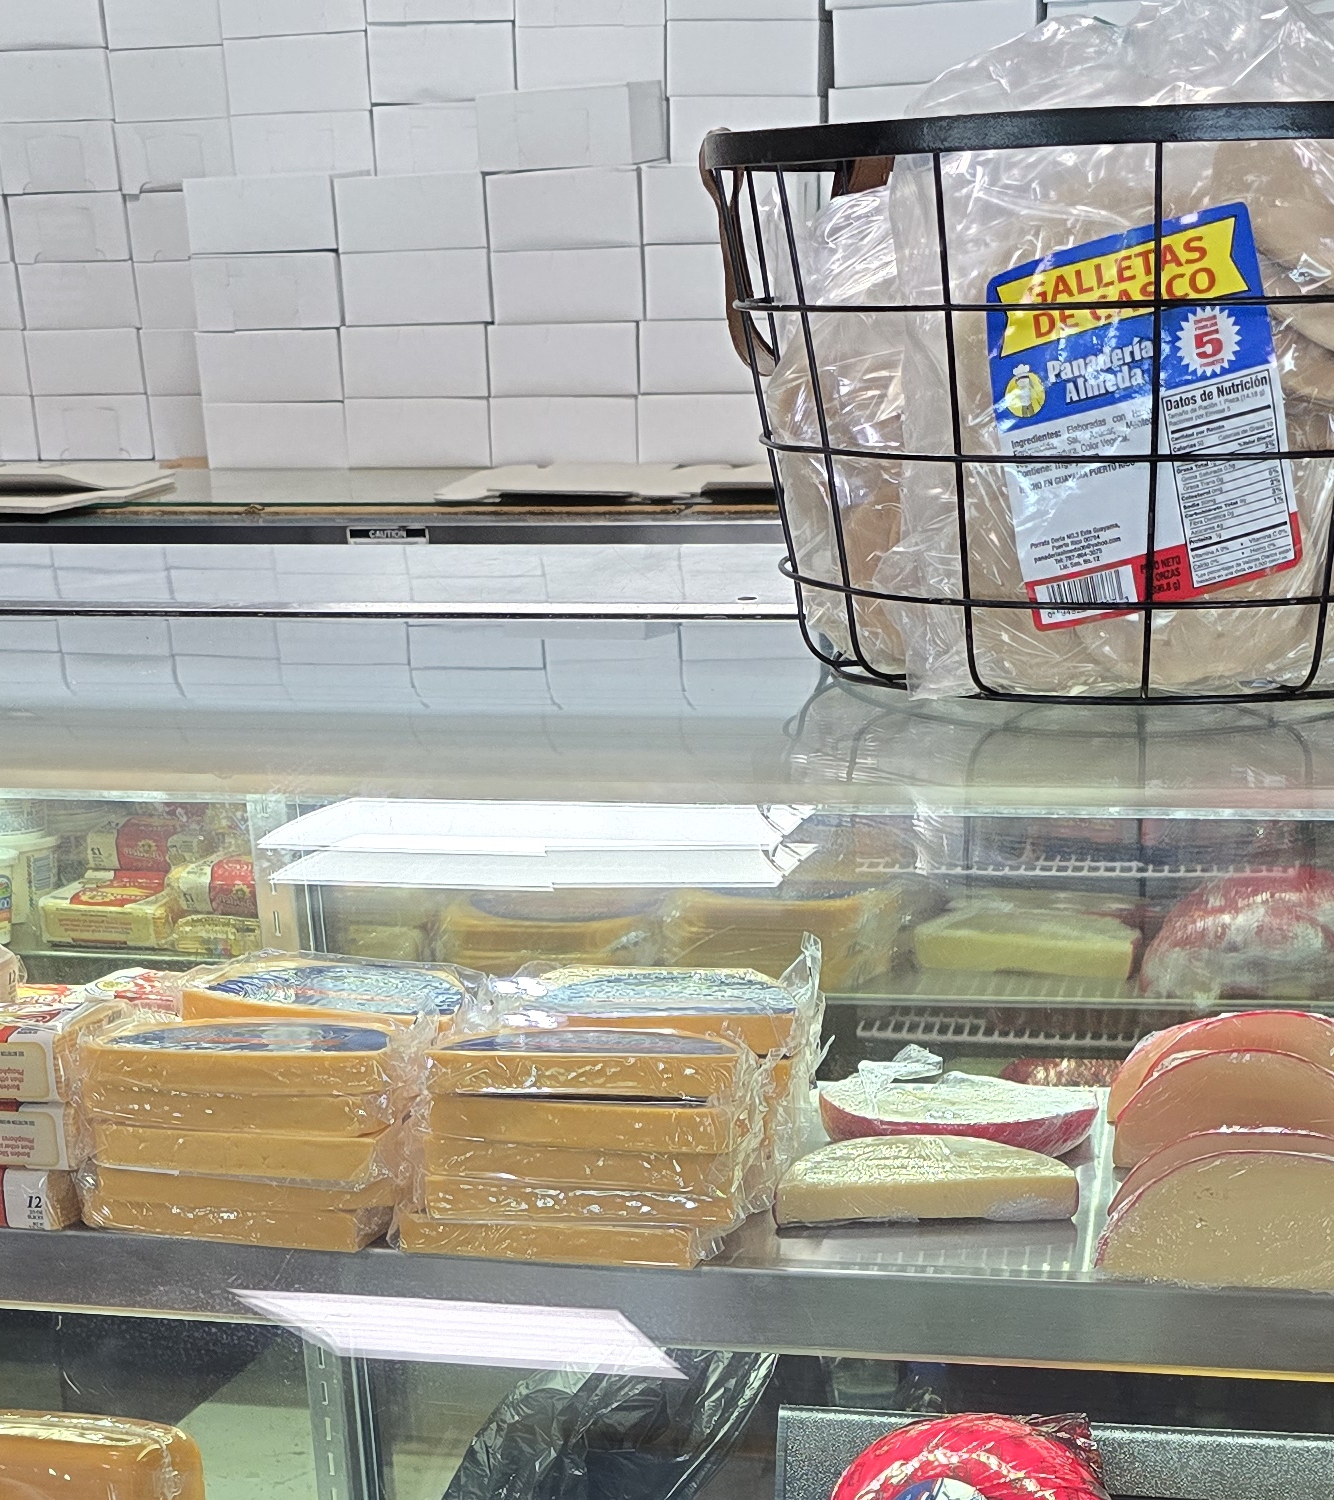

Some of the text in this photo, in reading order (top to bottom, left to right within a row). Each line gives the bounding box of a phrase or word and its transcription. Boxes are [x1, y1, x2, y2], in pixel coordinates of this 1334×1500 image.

[1193, 328, 1223, 359] 5
[1065, 366, 1145, 404] Almeda
[1166, 375, 1267, 411] Datos de Nutrición
[1011, 414, 1126, 449] Ingredientes: Elaboradas con
[1089, 464, 1117, 478] PUERTO
[1161, 555, 1181, 568] NETO
[0, 1083, 20, 1091] Borden
[27, 1196, 42, 1209] 12
